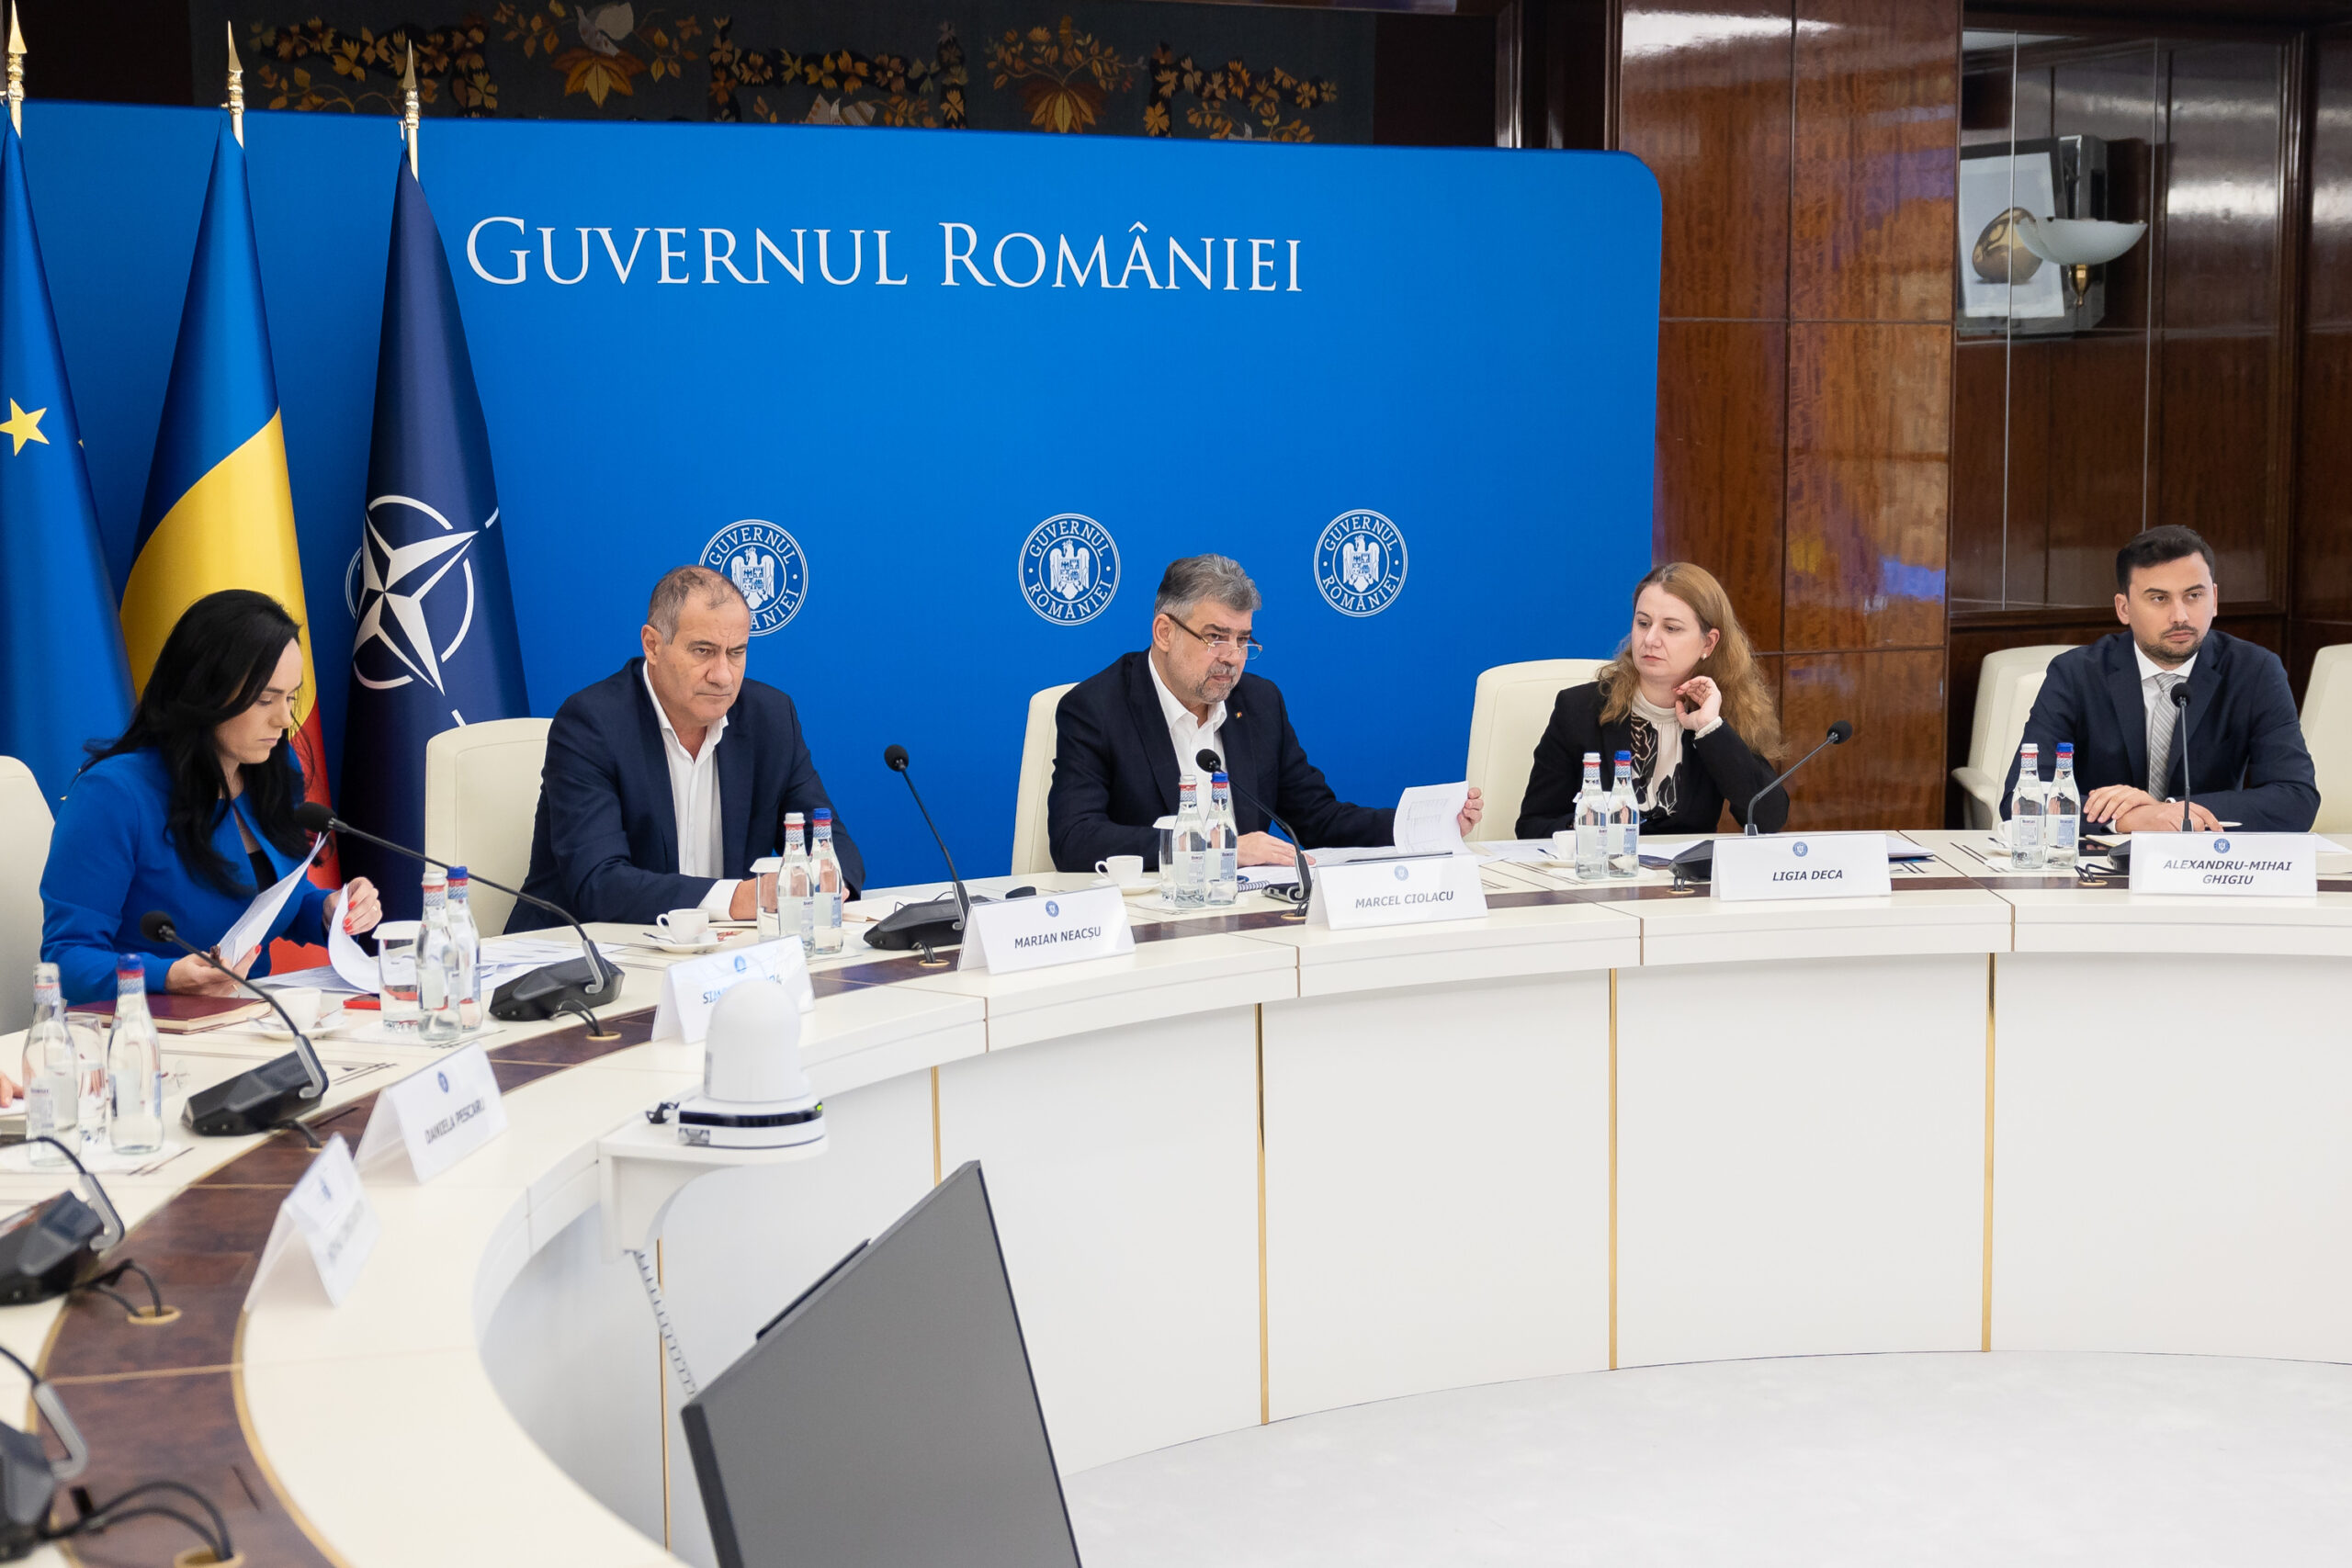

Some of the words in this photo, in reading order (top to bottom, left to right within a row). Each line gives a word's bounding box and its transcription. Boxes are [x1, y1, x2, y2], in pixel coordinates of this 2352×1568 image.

[467, 216, 908, 286] GUVERNUL
[938, 220, 1303, 292] ROMÂNIEI
[1029, 520, 1110, 557] GUVERNUL
[1324, 515, 1398, 551] GUVERNUL
[708, 526, 796, 565] GUVERNUL
[1772, 871, 1808, 882] LIGIA
[1811, 869, 1843, 881] DECA
[2163, 860, 2293, 872] ALEXANDRU-MIHAI
[2202, 874, 2254, 885] GHIGIU
[1355, 895, 1401, 909] MARCEL
[1404, 890, 1454, 905] CIOLACU
[1014, 932, 1057, 949] MARIAN
[424, 1116, 456, 1145] DANIELA
